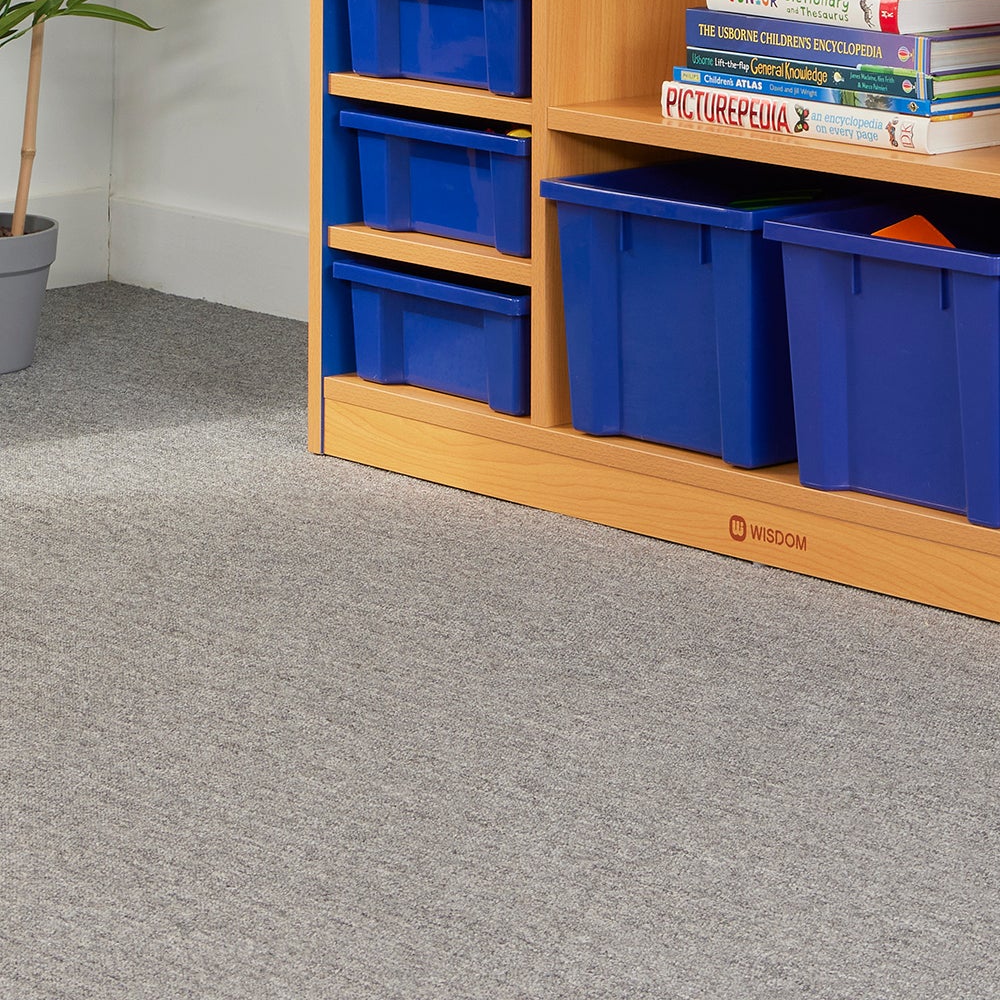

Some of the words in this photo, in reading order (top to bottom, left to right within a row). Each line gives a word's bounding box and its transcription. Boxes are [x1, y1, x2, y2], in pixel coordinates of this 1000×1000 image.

[800, 6, 849, 22] Thesaurus
[699, 23, 716, 37] THE
[717, 26, 759, 43] USBORNE
[760, 32, 812, 50] CHILDREN'S
[813, 38, 883, 59] ENCYCLOPEDIA
[692, 53, 714, 66] Usborne
[715, 58, 750, 73] Lift-the-flap
[750, 57, 784, 77] General
[785, 62, 828, 85] Knowledge
[704, 74, 734, 86] Children's
[735, 81, 763, 90] ATLAS
[770, 84, 783, 92] David
[800, 89, 817, 97] Wright
[666, 87, 793, 134] PICTUREPEDIA
[811, 112, 822, 121] an
[825, 115, 883, 130] encyclopedia
[816, 124, 826, 133] on
[829, 126, 854, 139] every
[856, 130, 878, 142] page
[751, 524, 807, 551] WISDOM
